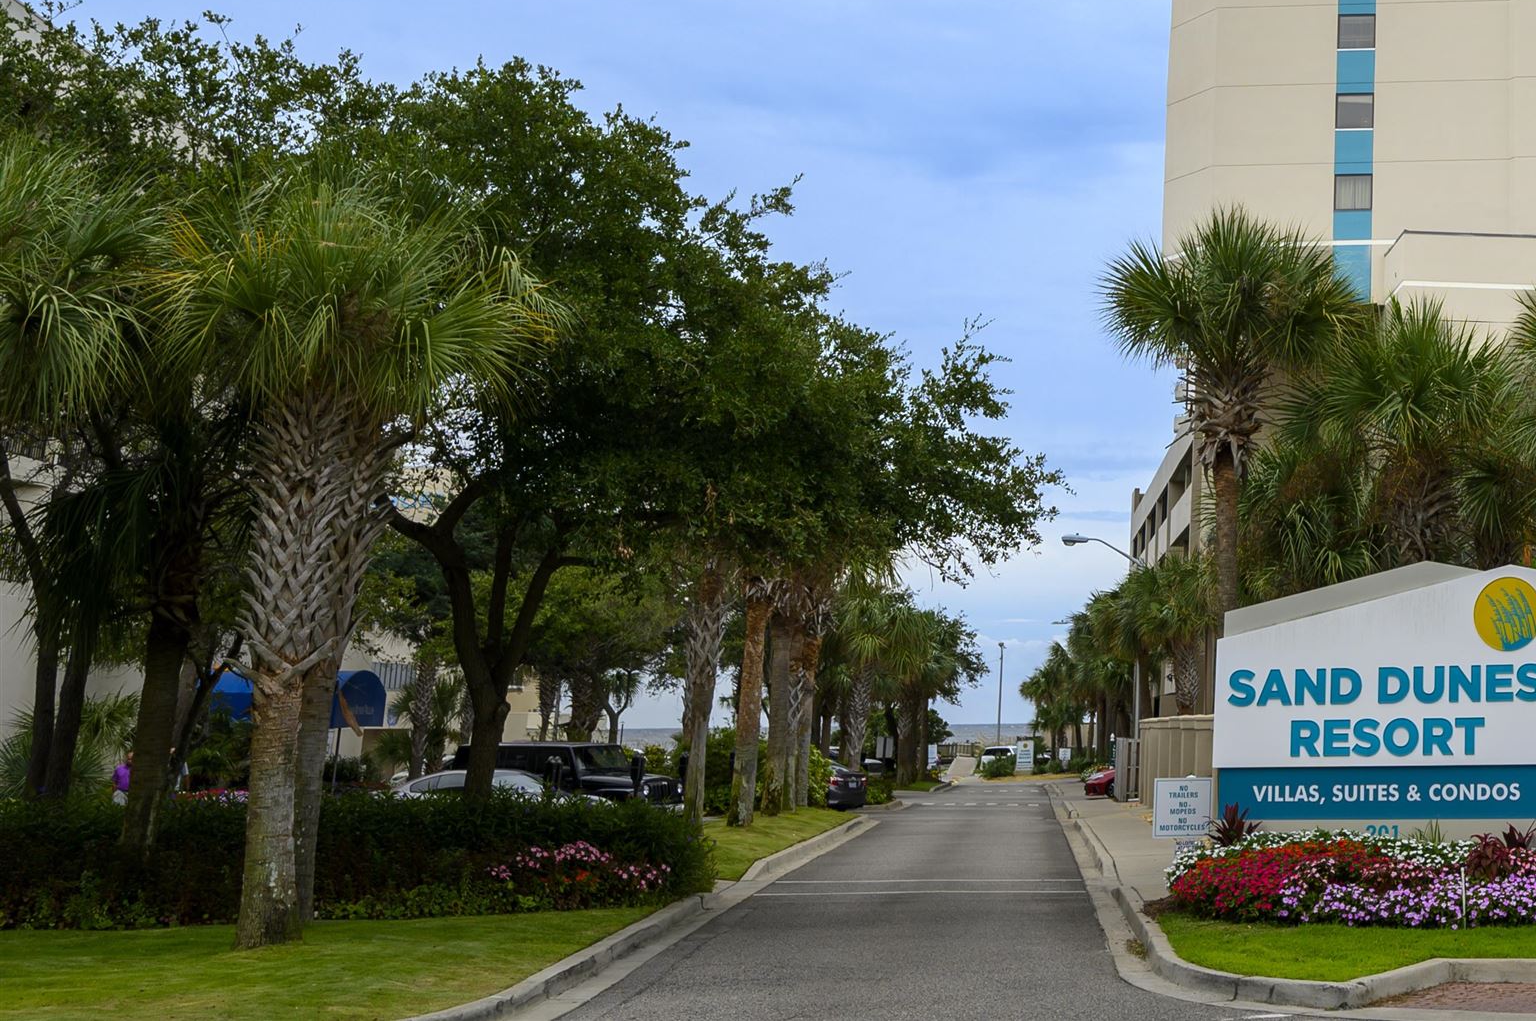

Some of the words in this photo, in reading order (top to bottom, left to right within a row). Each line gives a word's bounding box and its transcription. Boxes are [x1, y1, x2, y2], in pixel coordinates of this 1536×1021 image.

[1227, 668, 1363, 707] SAND
[1290, 717, 1485, 757] RESORT
[1253, 784, 1326, 805] VILLAS,
[1332, 783, 1399, 802] SUITES
[1406, 783, 1422, 801] &
[1428, 782, 1521, 801] CONDOS
[1365, 824, 1399, 838] 201
